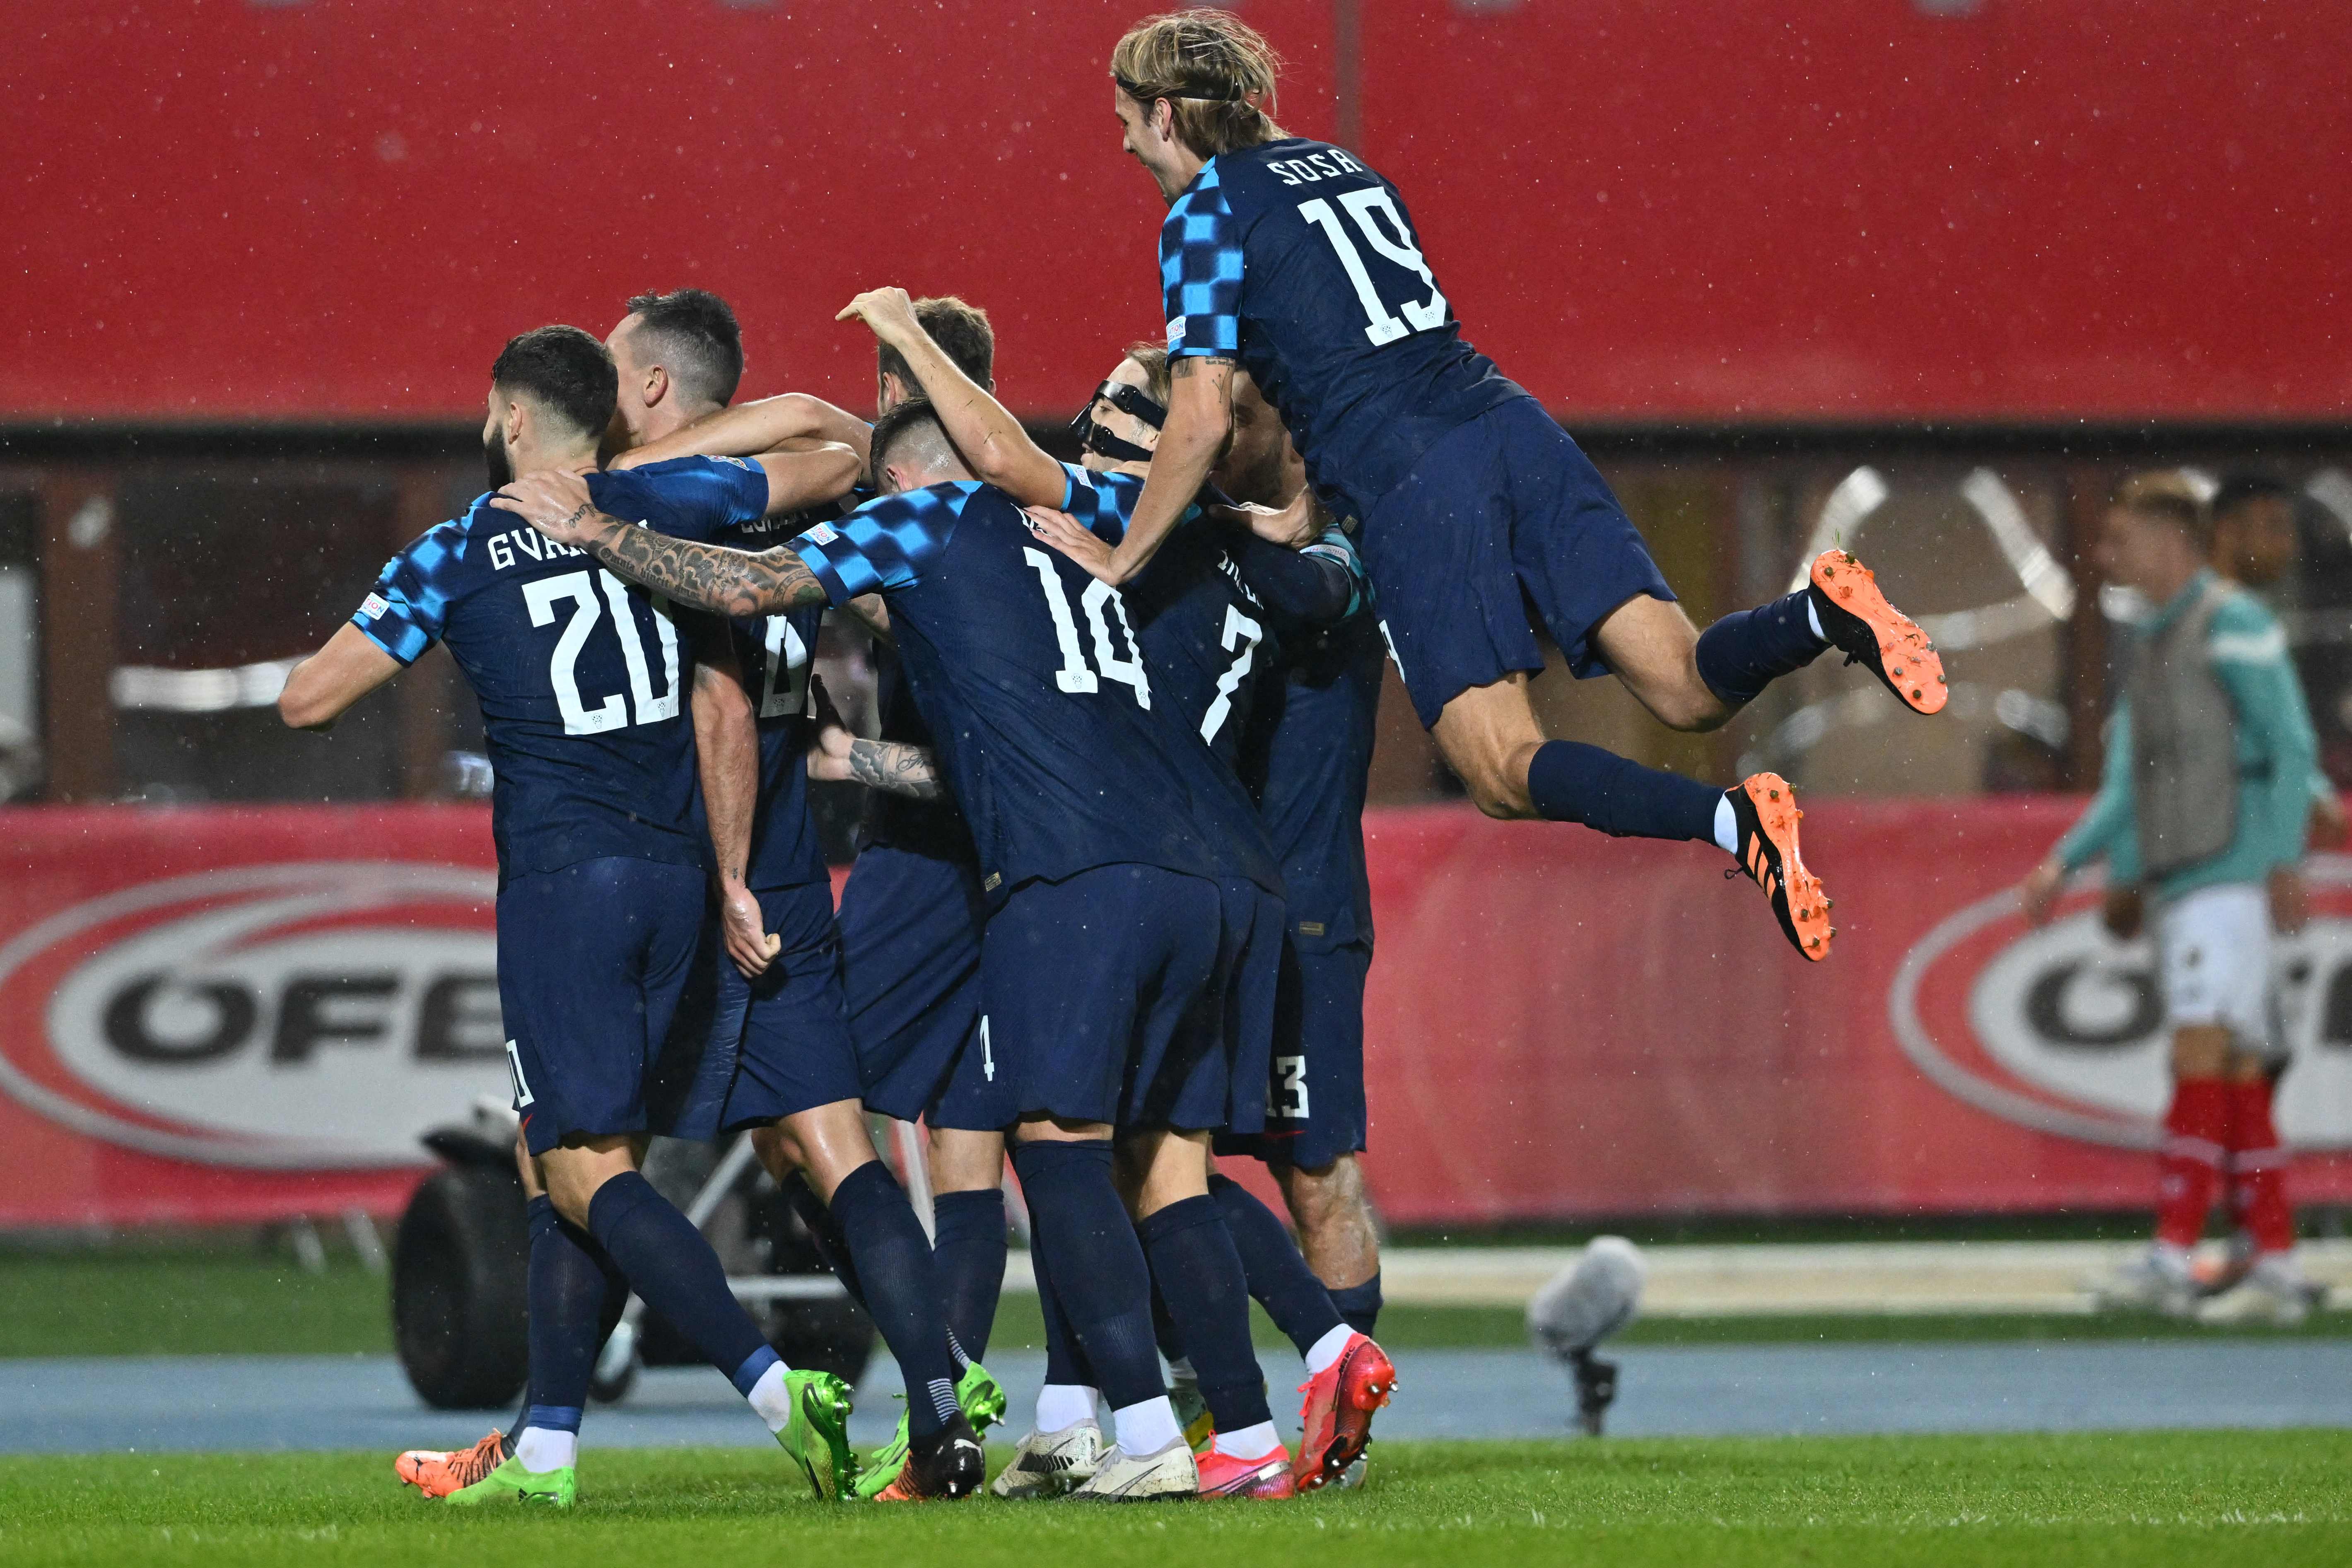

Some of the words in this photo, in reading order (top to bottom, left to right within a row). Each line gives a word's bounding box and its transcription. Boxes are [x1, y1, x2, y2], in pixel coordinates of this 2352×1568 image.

[1267, 149, 1363, 186] SOSA
[1297, 186, 1446, 347] 19
[521, 569, 678, 735] 20
[1023, 546, 1152, 710] 14
[1200, 603, 1262, 746] 7
